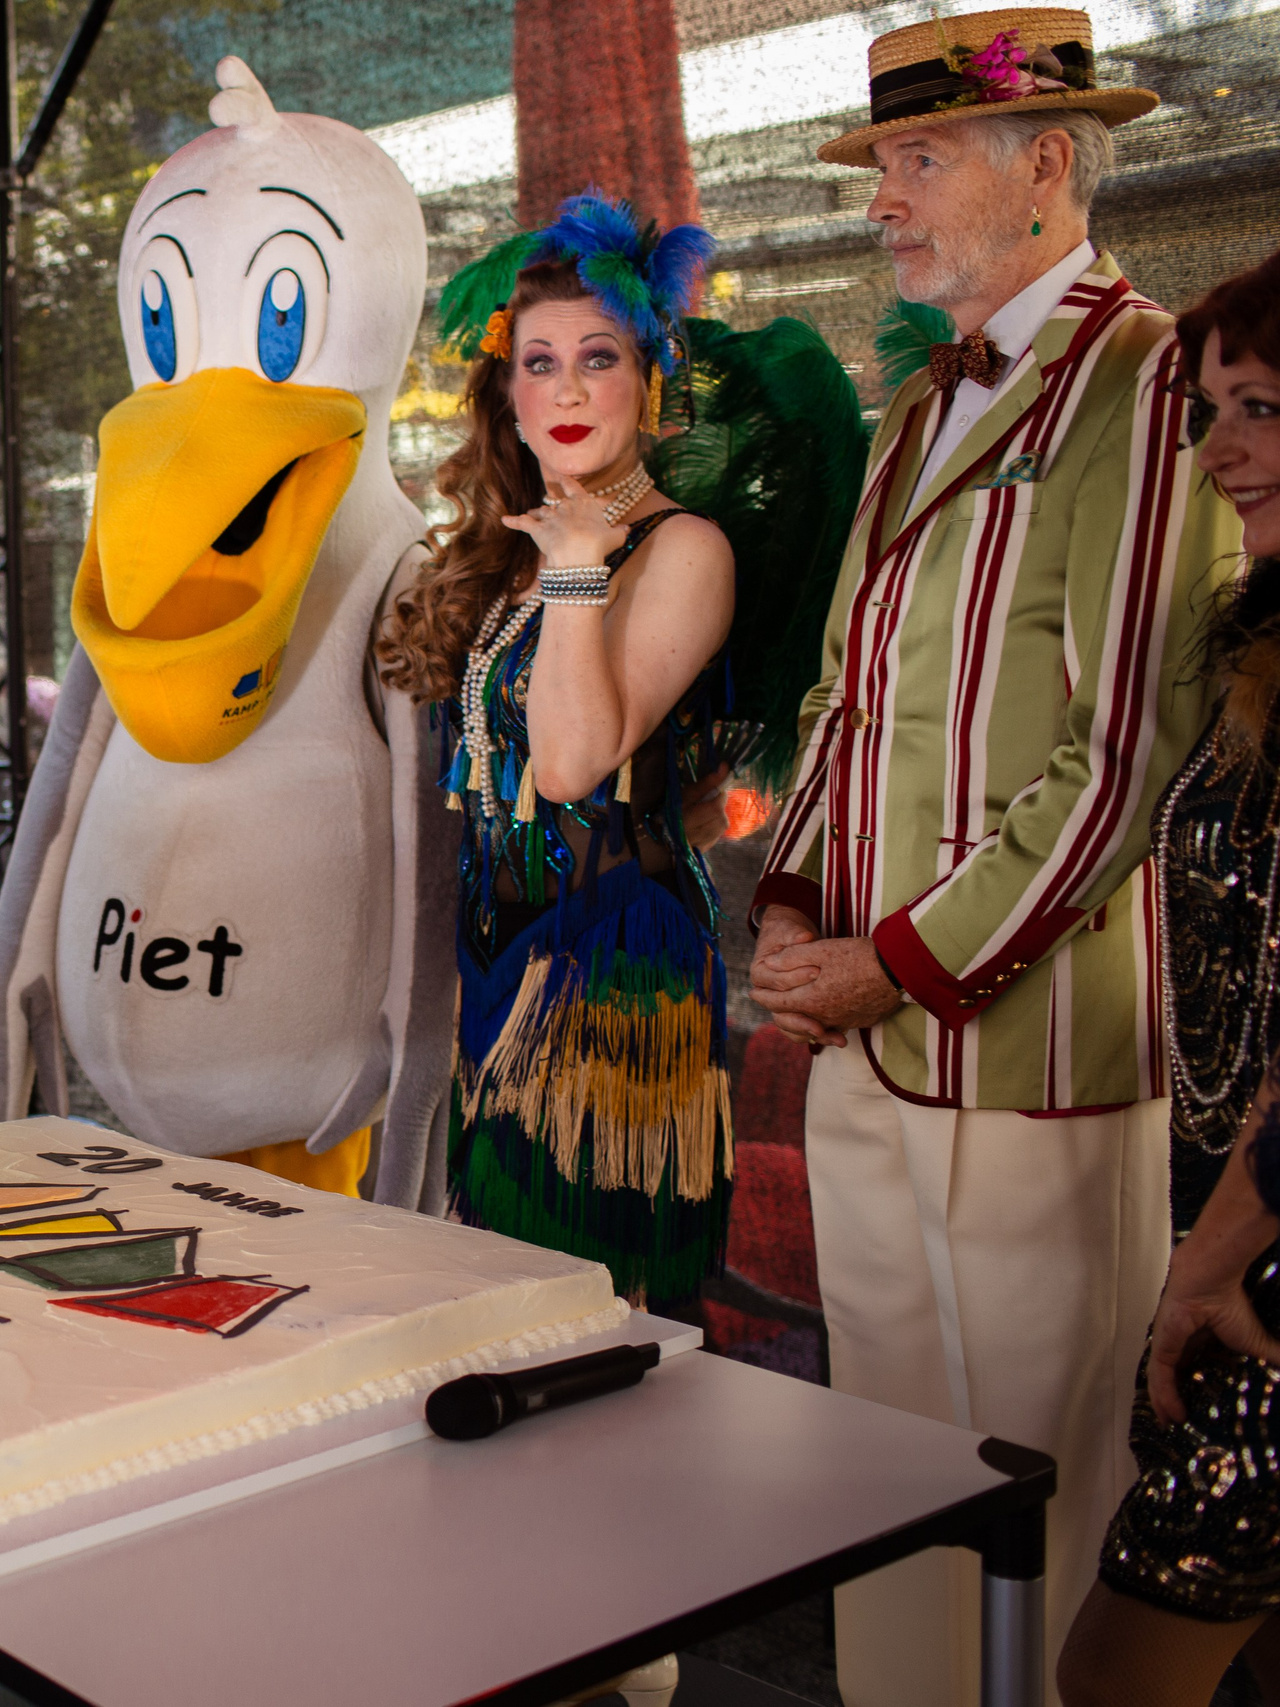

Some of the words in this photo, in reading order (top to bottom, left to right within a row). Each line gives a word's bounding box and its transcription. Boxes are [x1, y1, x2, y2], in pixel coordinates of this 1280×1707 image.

[222, 700, 259, 718] KAMP
[93, 898, 243, 997] Piet
[36, 1146, 163, 1174] 20
[172, 1182, 304, 1218] JAHRE
